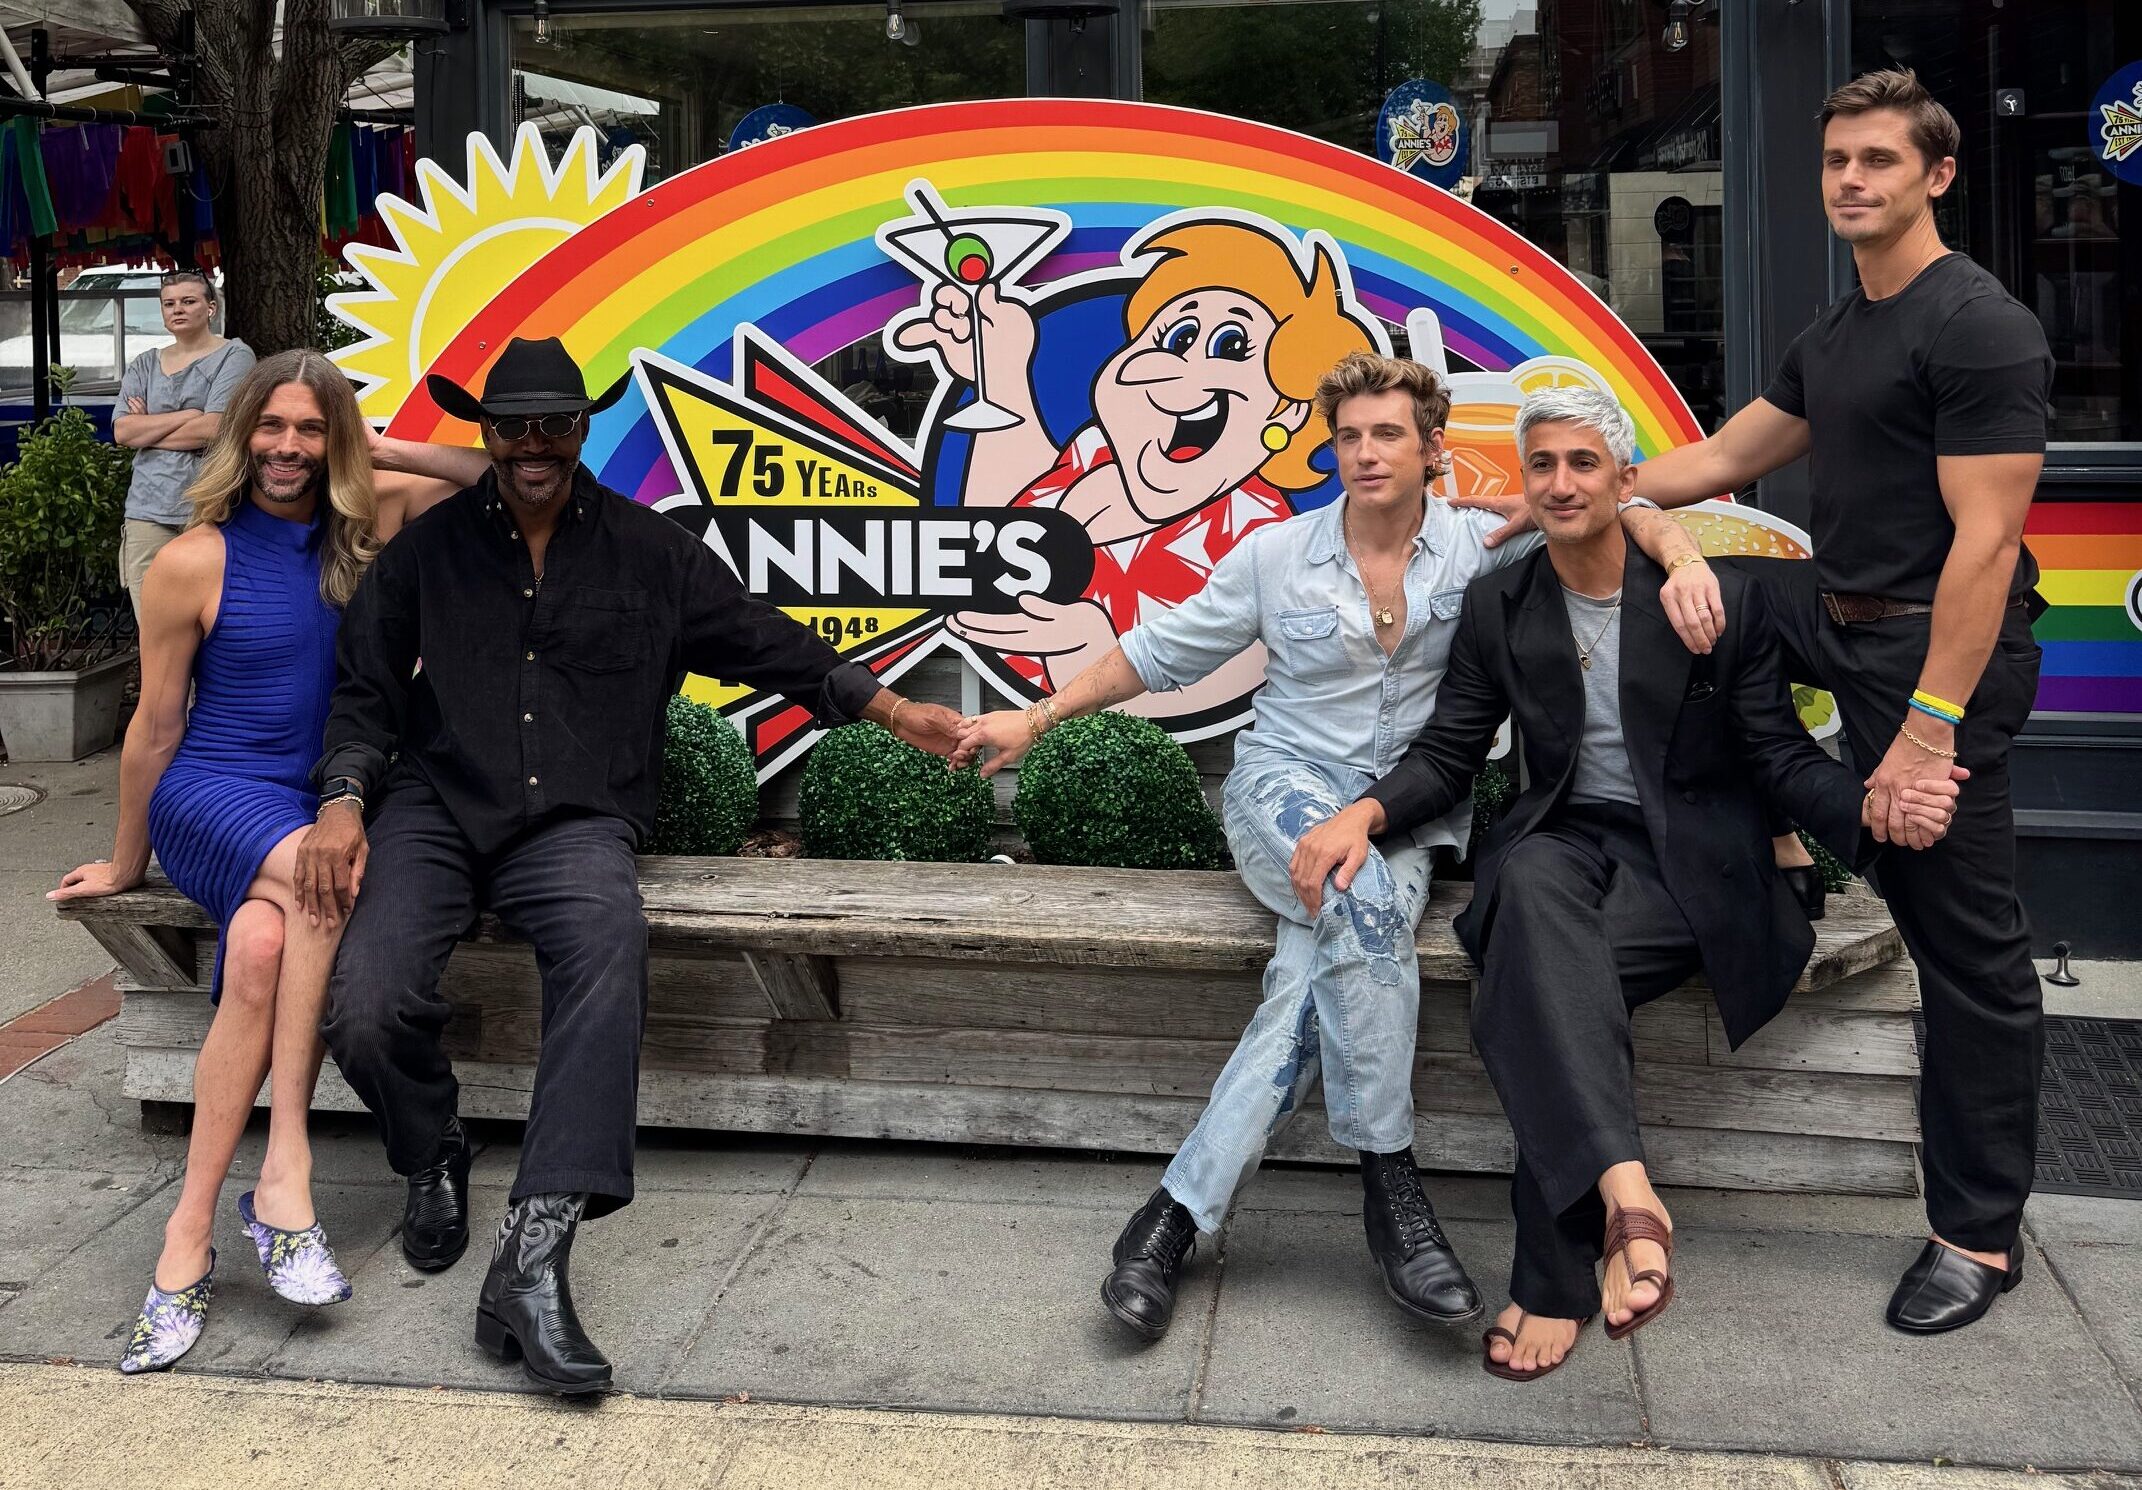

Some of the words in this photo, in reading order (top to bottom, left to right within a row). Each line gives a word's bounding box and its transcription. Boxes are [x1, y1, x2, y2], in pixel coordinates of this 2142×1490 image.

[2110, 124, 2142, 136] ANNI
[1398, 138, 1432, 149] ANNIE'S
[712, 429, 785, 498] 75
